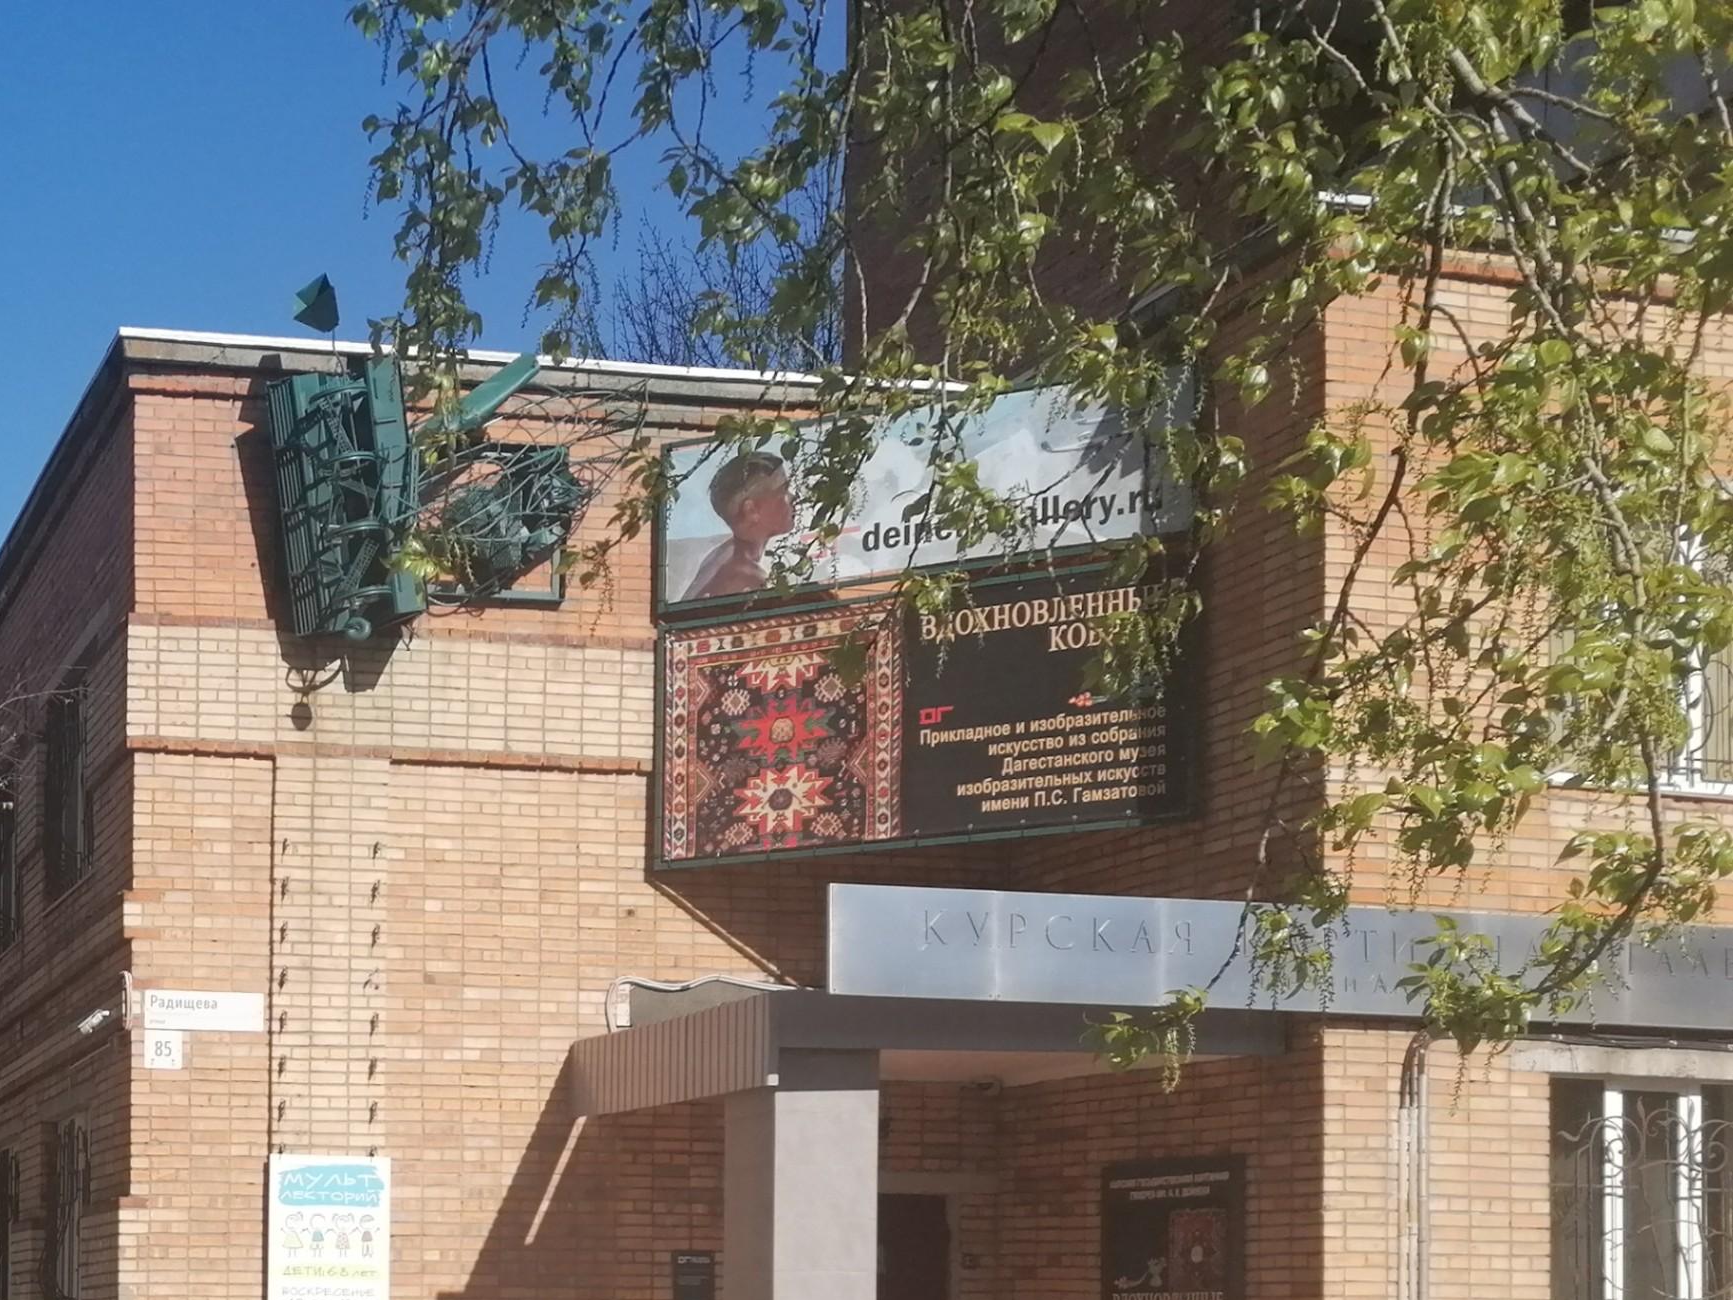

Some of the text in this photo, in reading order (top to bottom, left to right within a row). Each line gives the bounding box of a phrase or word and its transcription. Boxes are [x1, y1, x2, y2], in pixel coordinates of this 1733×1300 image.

[920, 705, 1166, 747] Прикладное и изобразительное
[988, 724, 1166, 757] искусство из собрания
[1001, 743, 1166, 776] Дагестанского музея
[956, 761, 1166, 797] изобразительных искусств
[981, 781, 1166, 813] имени П.С. Гамзатовой
[921, 909, 1194, 955] КУРСКАЯ
[149, 994, 218, 1010] Радищева
[154, 1040, 172, 1057] 85
[281, 1190, 378, 1204] ЛЕКТОРИЙ
[284, 1173, 378, 1190] МУЛЬТ
